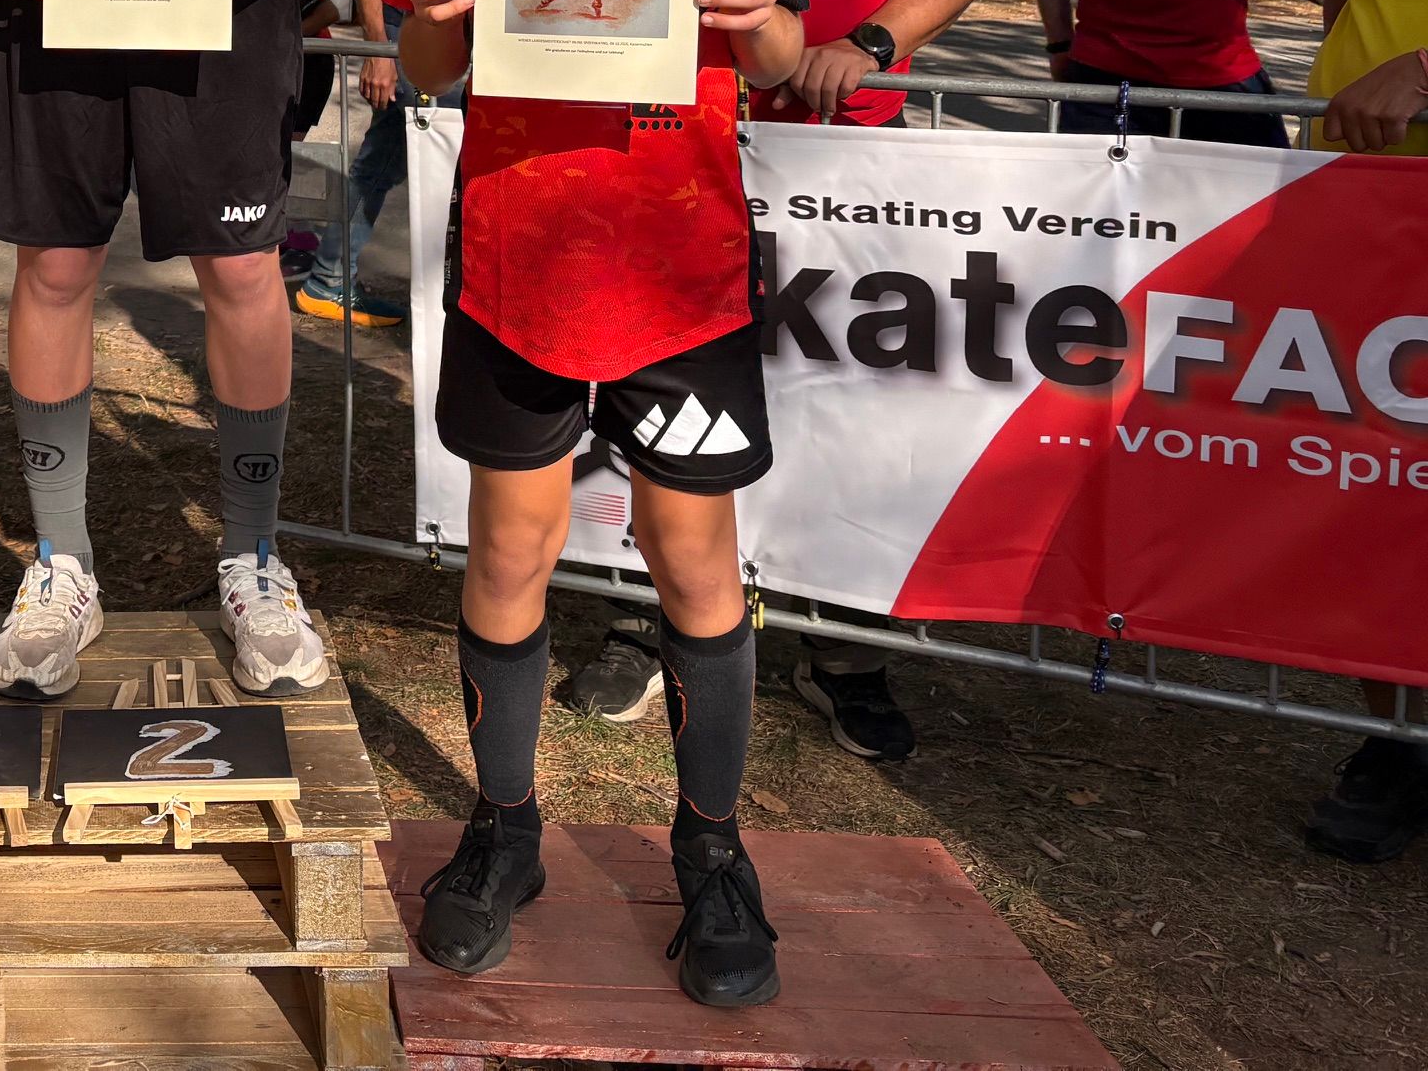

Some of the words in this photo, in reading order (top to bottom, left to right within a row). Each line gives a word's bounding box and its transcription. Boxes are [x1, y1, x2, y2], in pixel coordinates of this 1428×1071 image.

[221, 203, 267, 223] JAKO
[788, 195, 982, 235] Skating
[1002, 206, 1178, 243] Verein
[1116, 425, 1259, 468] vom
[125, 718, 235, 781] 2
